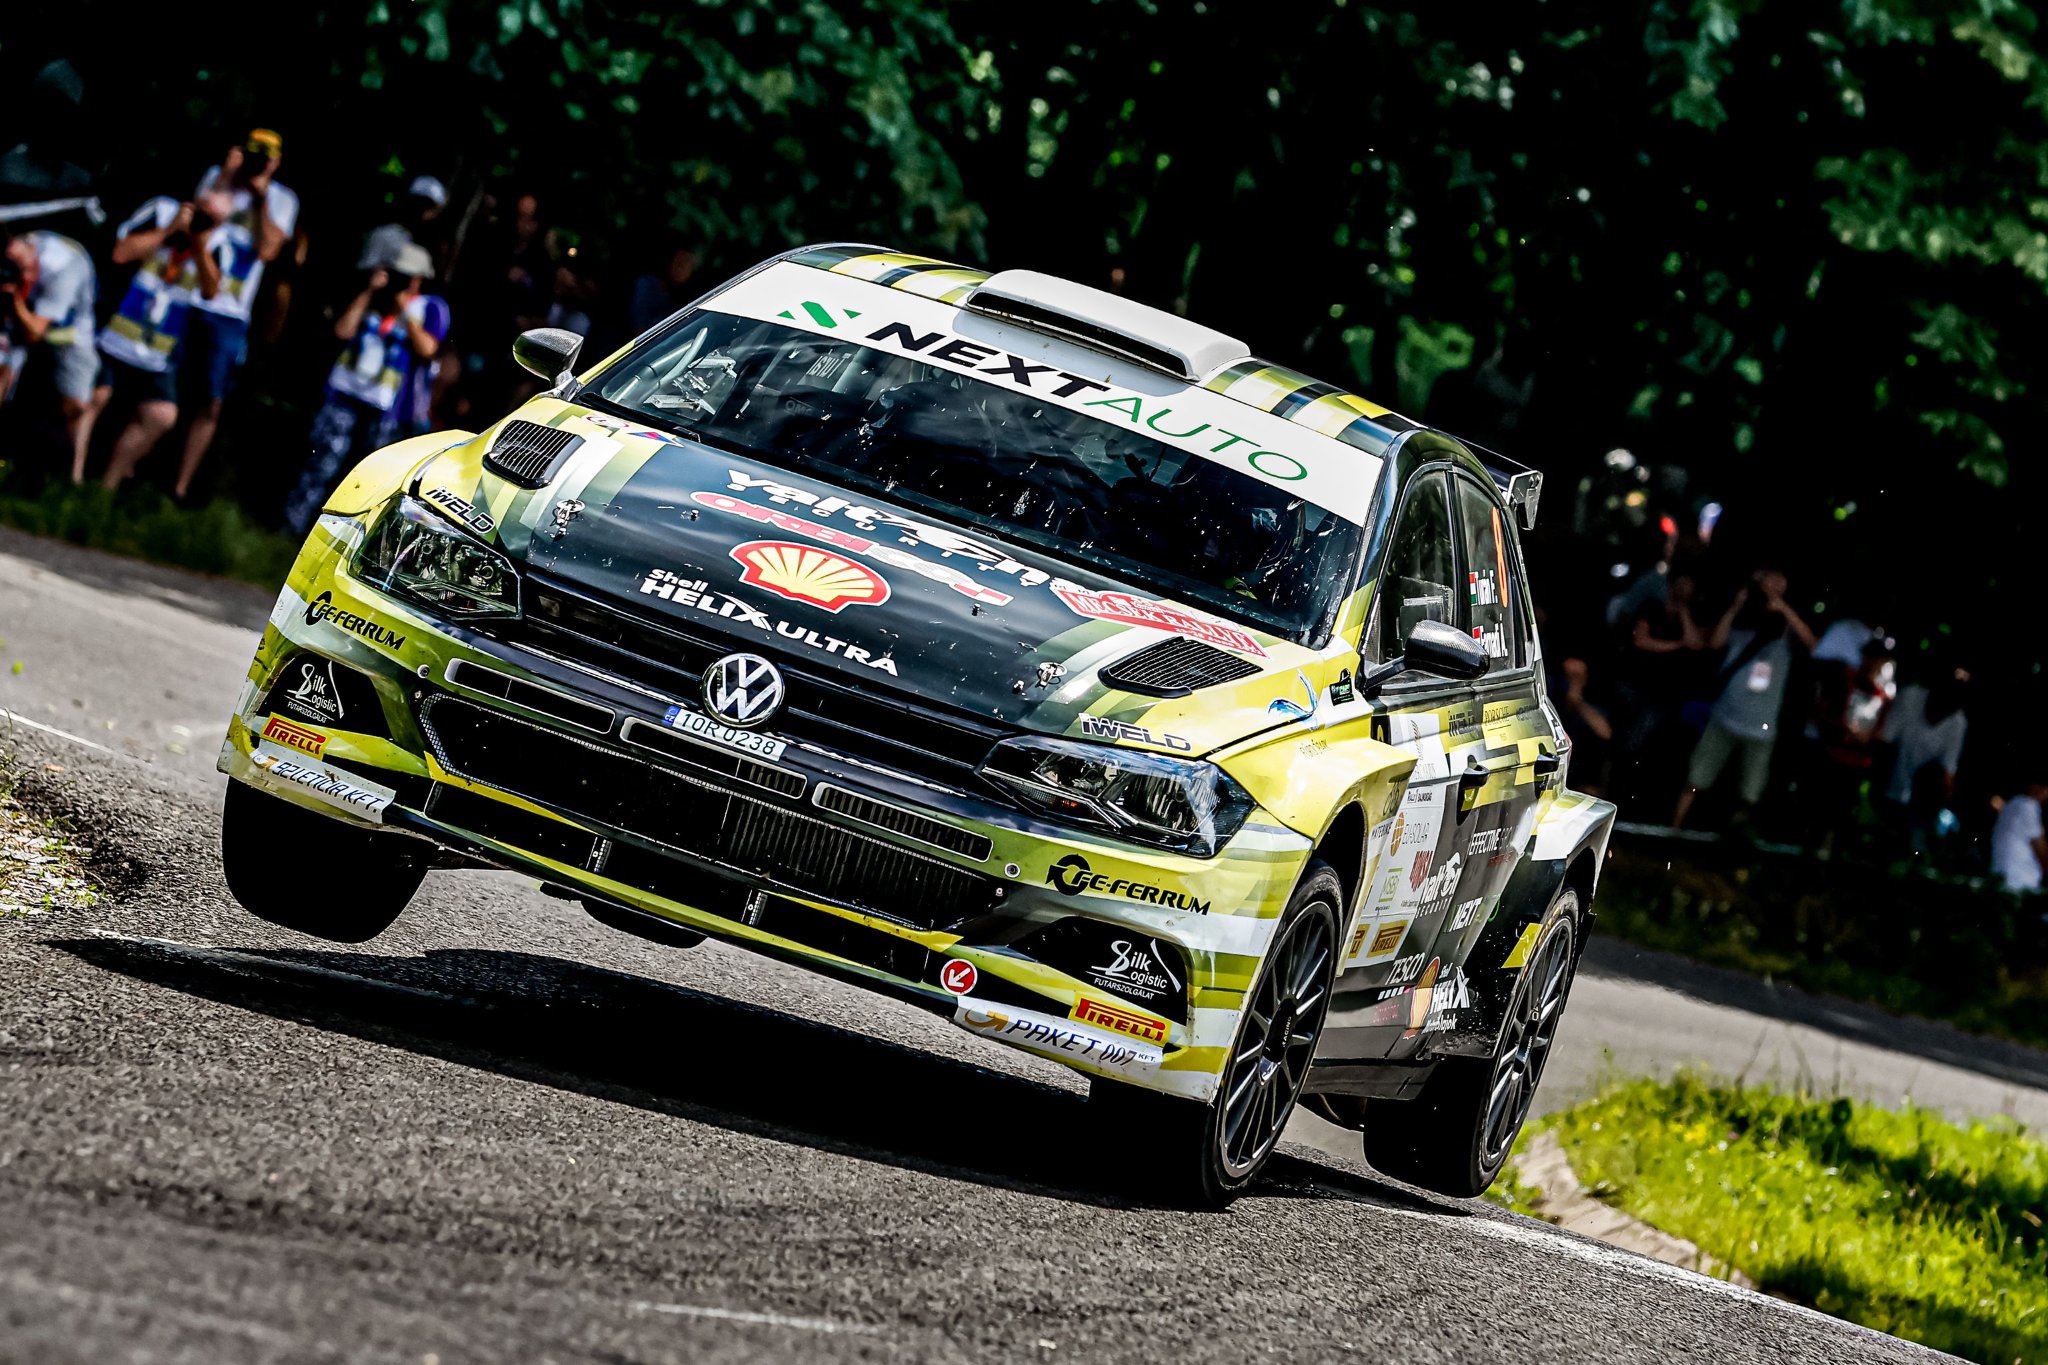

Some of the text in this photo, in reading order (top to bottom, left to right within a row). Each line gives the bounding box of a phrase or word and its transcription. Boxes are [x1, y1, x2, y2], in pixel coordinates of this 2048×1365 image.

[648, 568, 709, 593] Shell
[639, 577, 899, 677] HELIX ULTRA
[264, 717, 327, 755] PIRELLI
[1385, 952, 1426, 985] TESCO
[1094, 977, 1155, 1000] FUTÁRSZOLGÁLAT
[1075, 998, 1166, 1041] PIRELLI
[1005, 1019, 1102, 1055] PAKET
[1099, 1044, 1137, 1066] 007
